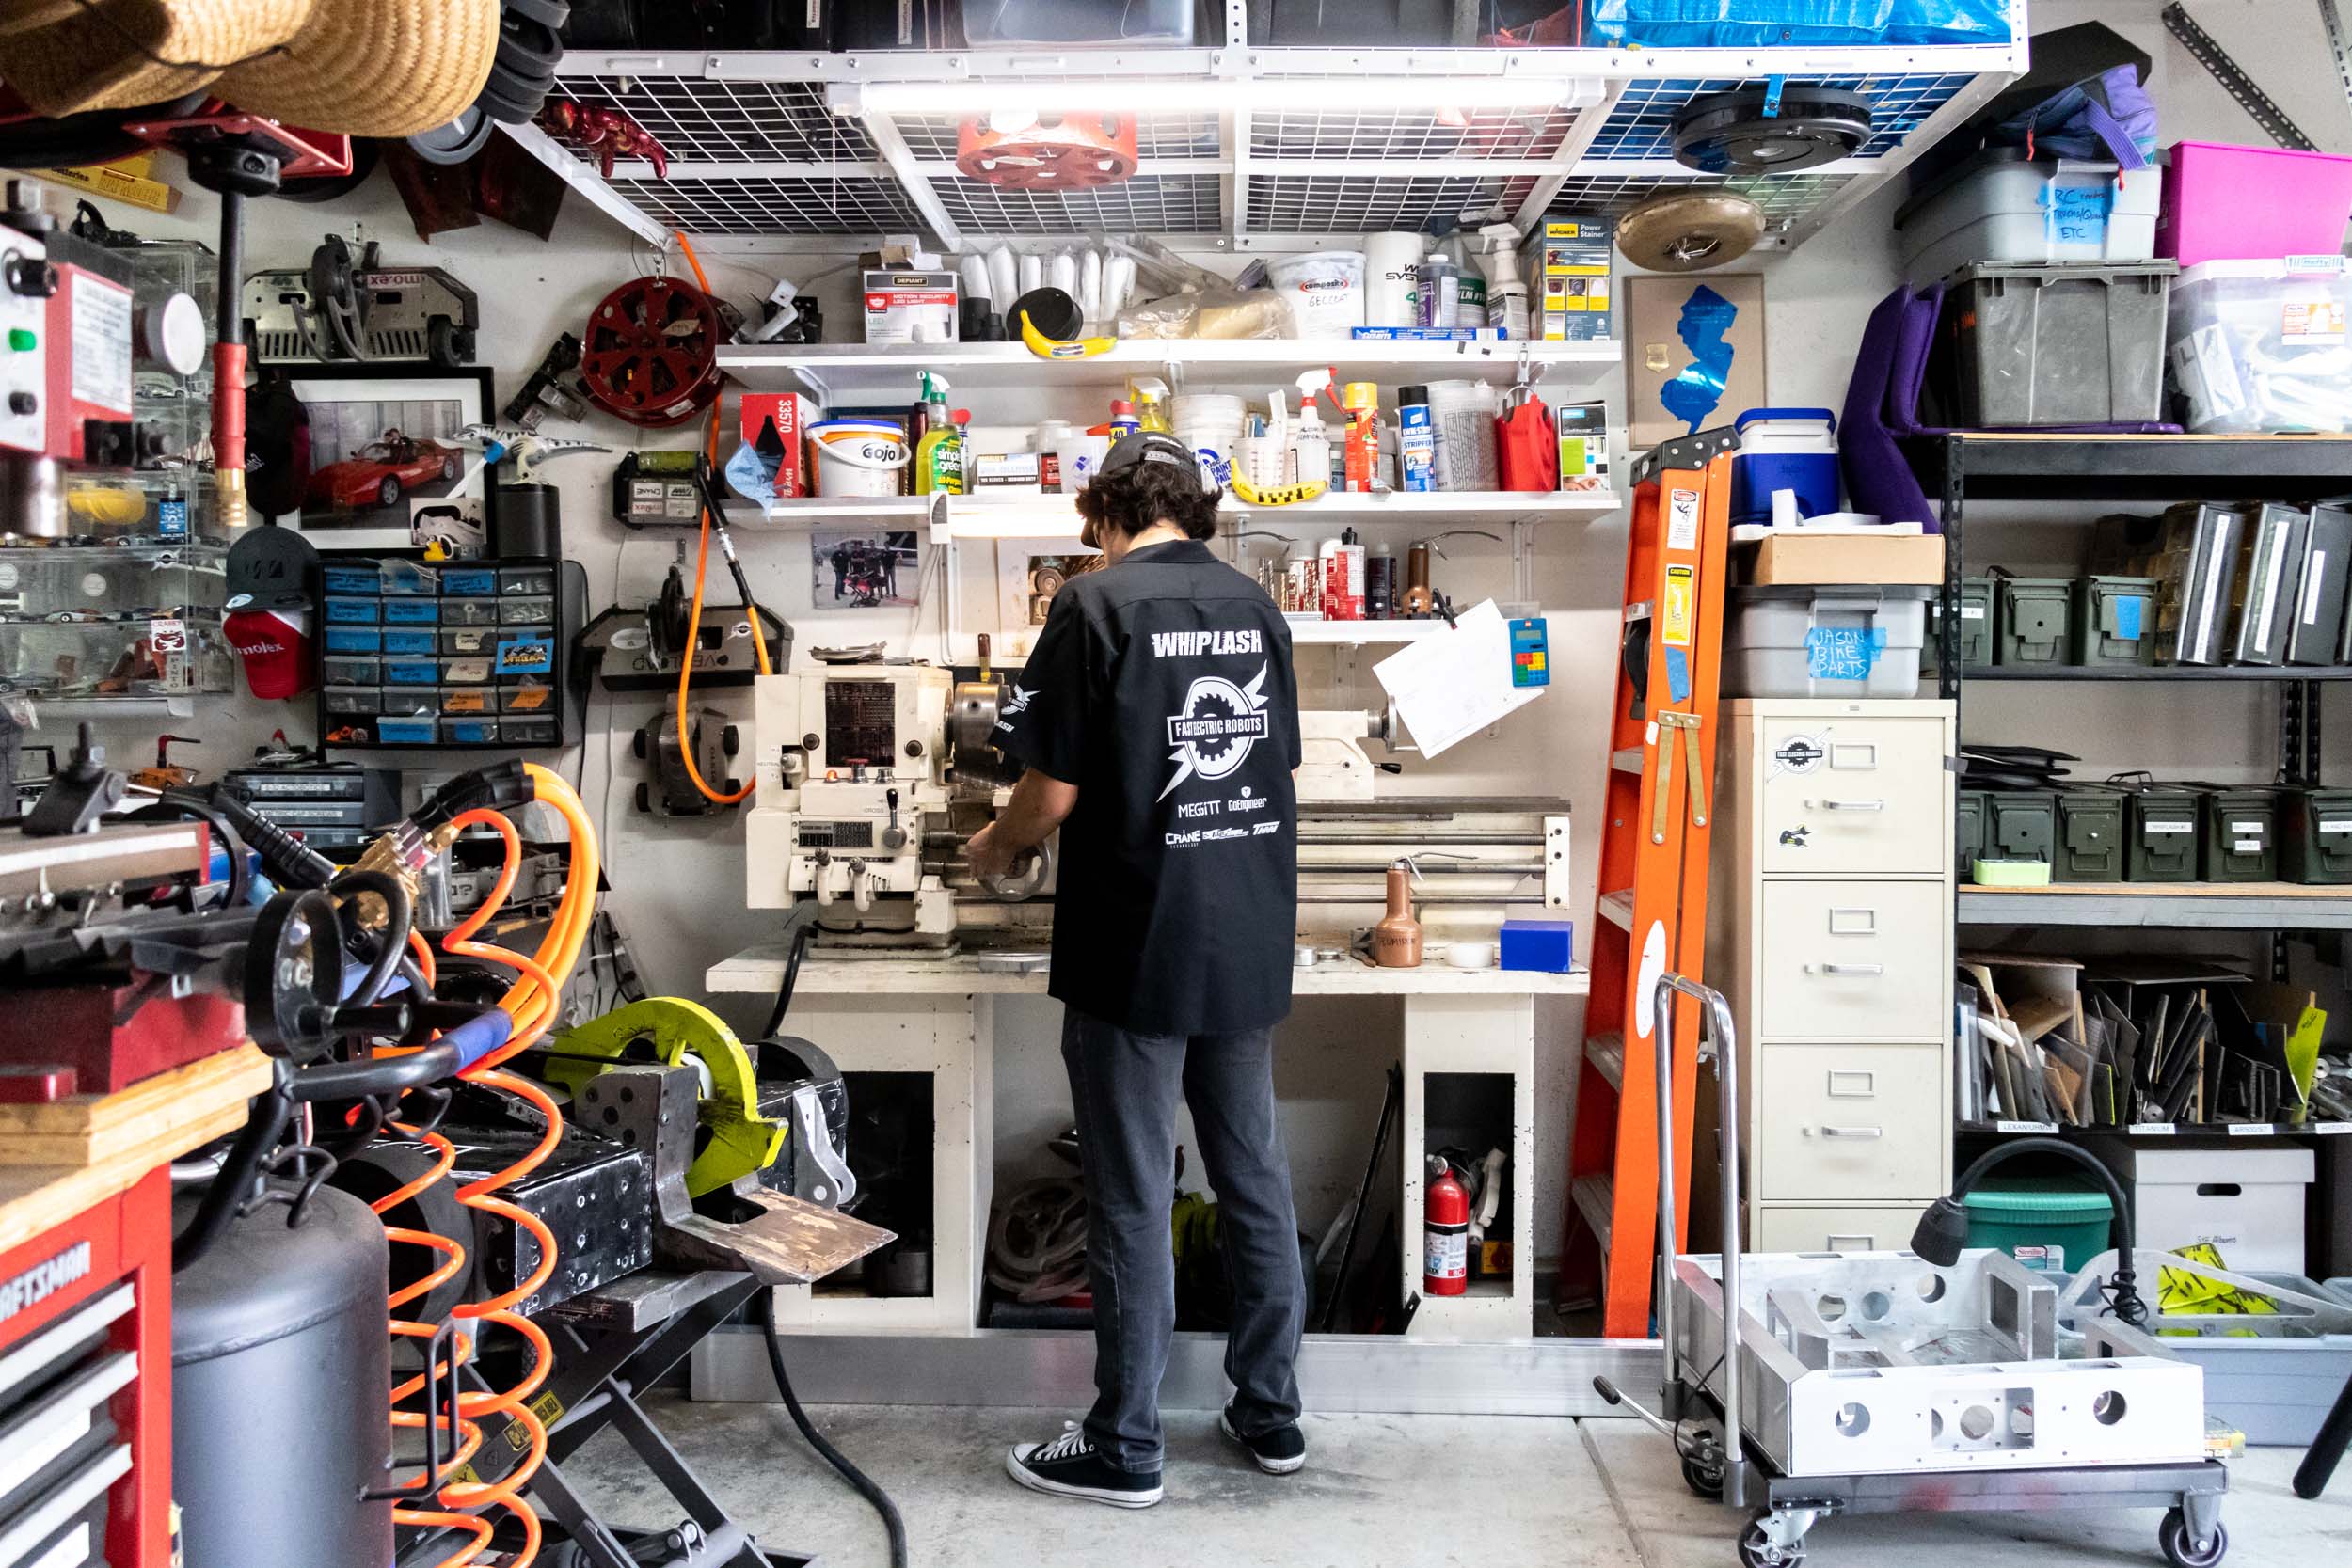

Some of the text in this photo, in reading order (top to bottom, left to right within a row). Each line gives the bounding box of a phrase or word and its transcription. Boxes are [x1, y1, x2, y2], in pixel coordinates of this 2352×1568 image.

[2060, 227, 2086, 239] ETC
[1305, 279, 1344, 290] composite
[1385, 273, 1419, 282] SYST
[778, 399, 793, 434] 33570
[862, 443, 896, 462] GOJO
[1211, 460, 1232, 477] PAINT
[1215, 473, 1232, 485] PAIL
[1152, 629, 1263, 657] WHIPLASH
[1815, 630, 1865, 646] JASON
[632, 654, 729, 670] OVELOAD
[1815, 645, 1860, 663] BIKE
[1813, 660, 1867, 677] PARTS
[1225, 717, 1262, 733] ROBOTS
[1228, 797, 1268, 812] GoEngineer
[1165, 829, 1200, 845] CRANE
[0, 1241, 92, 1320] AFTSMAN
